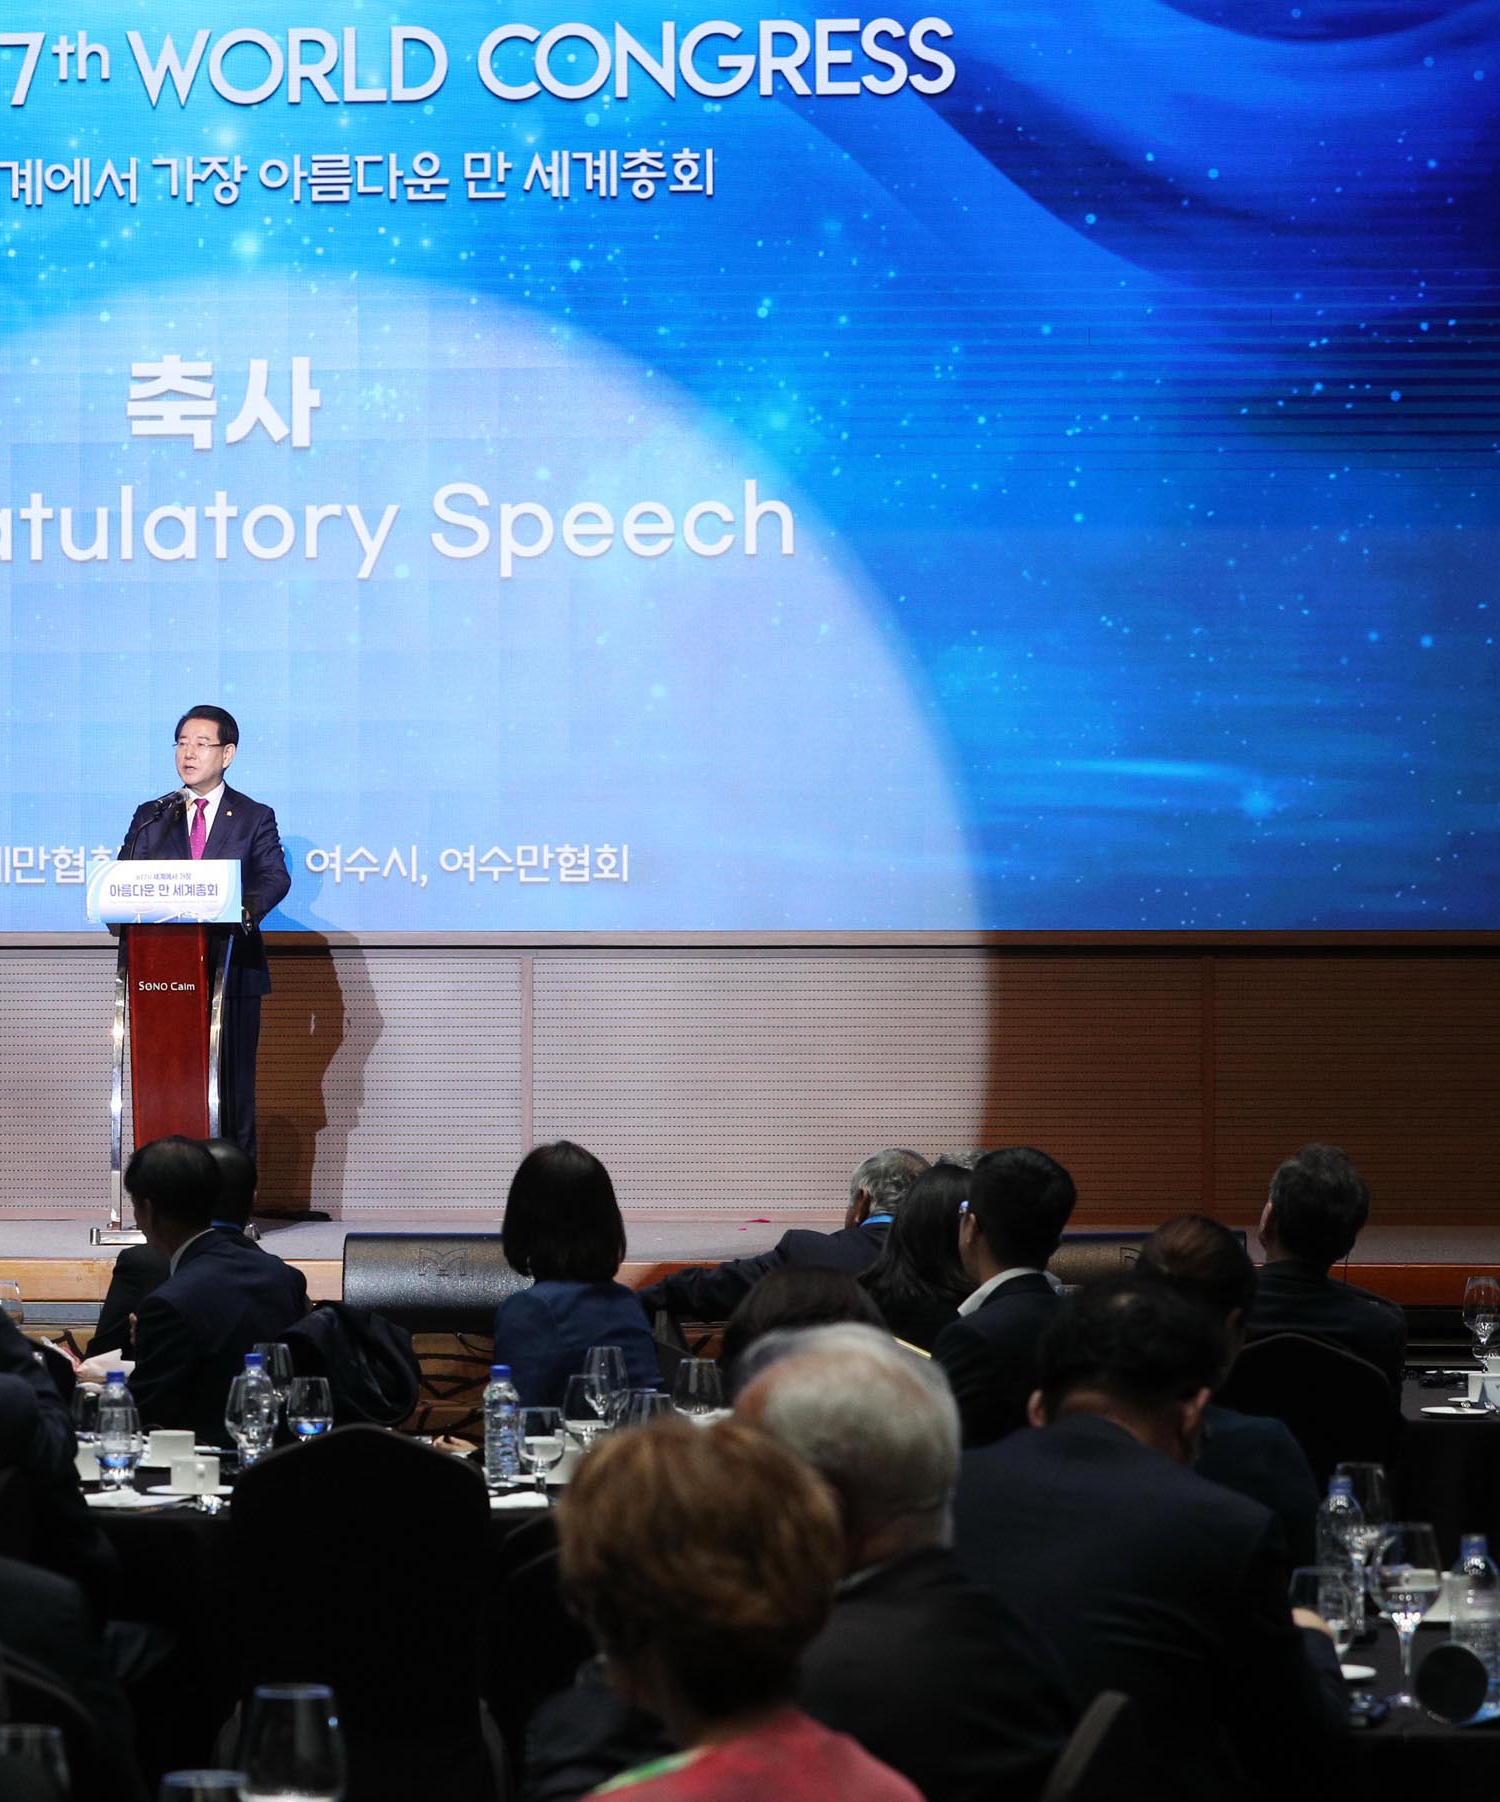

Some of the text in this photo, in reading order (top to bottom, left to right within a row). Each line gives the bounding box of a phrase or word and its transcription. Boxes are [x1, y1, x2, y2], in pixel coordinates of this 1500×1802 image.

[125, 25, 448, 108] WORLD
[477, 17, 956, 102] CONGRESS
[151, 154, 248, 205] 가장
[258, 152, 450, 202] 아름다운
[463, 151, 512, 200] 만
[522, 147, 716, 200] 세계총회
[125, 354, 322, 450] 축사
[429, 478, 796, 579] Speech
[109, 883, 219, 898] 아름다운 만 세계총회
[304, 843, 630, 888] 여수시, 여수만협회
